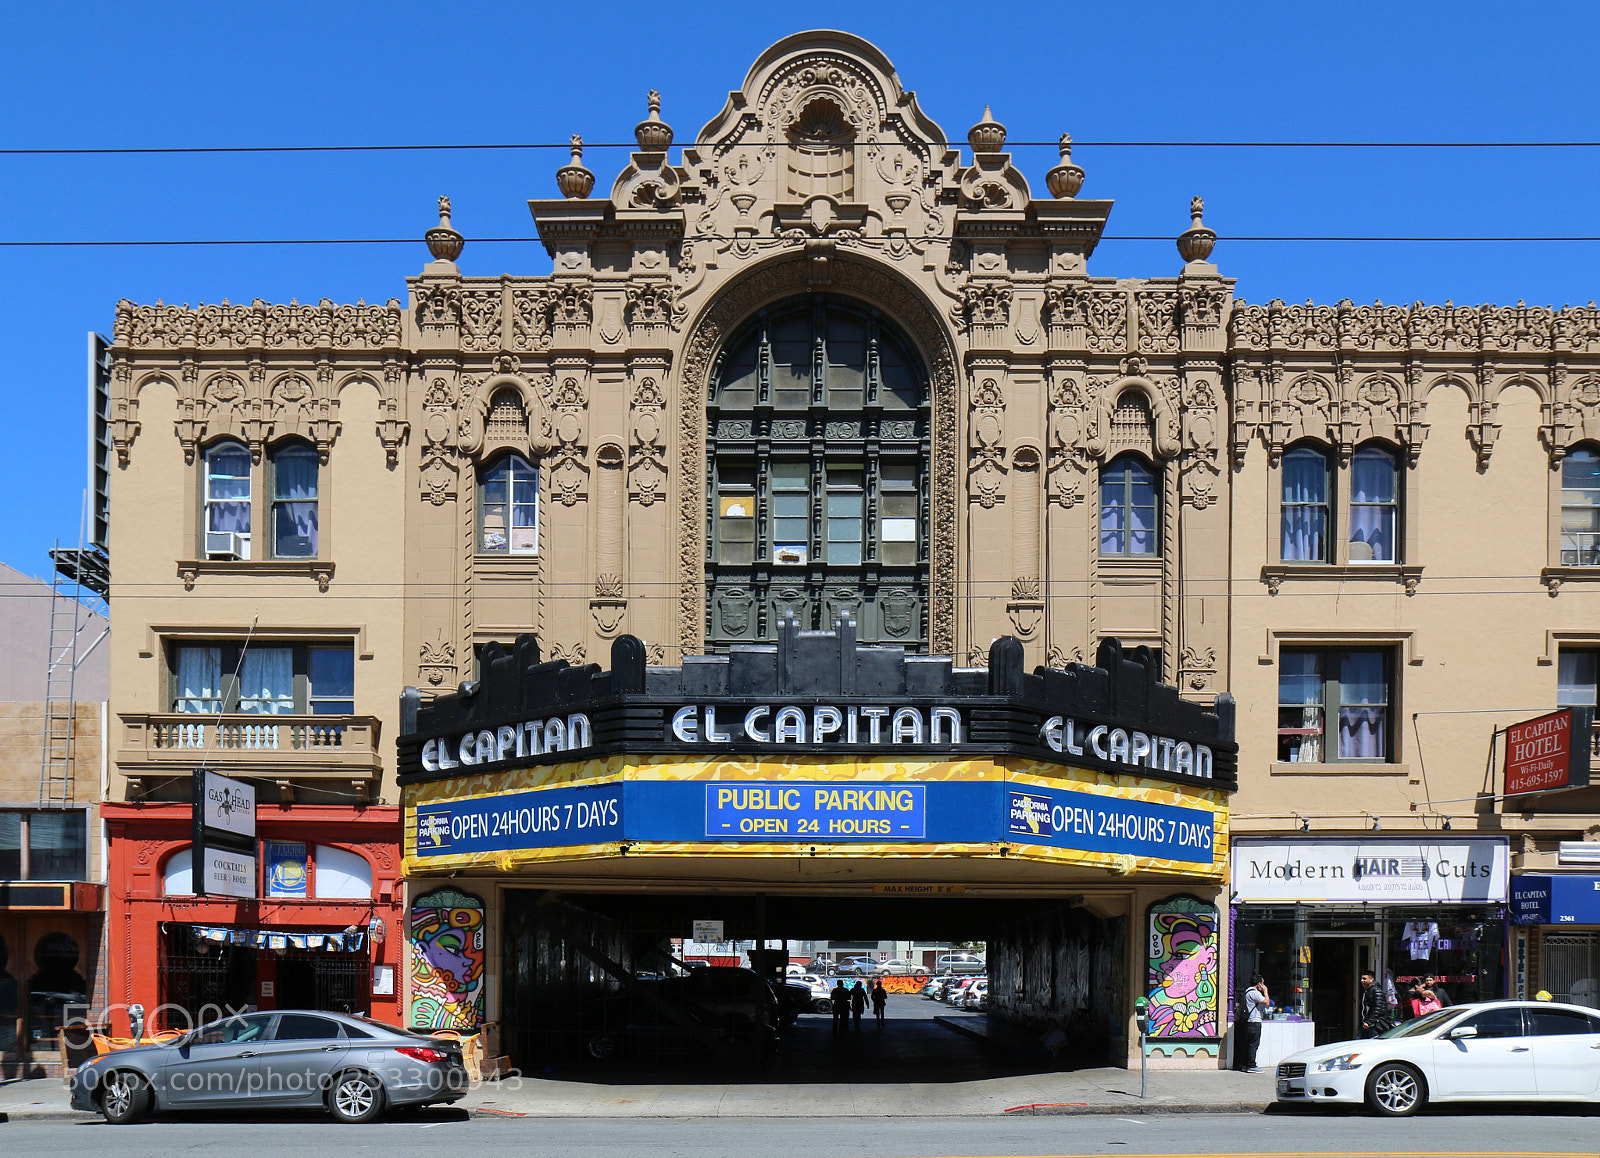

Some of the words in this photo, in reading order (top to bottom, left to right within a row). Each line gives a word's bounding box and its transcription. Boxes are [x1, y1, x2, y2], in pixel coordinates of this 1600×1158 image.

[672, 705, 731, 743] EL
[744, 705, 962, 744] CAPITAN
[1510, 730, 1523, 744] EL
[1524, 715, 1569, 739] CAPITAN
[421, 737, 459, 772] EL
[459, 713, 593, 766] CAPITAN
[1040, 715, 1083, 756] EL
[1085, 725, 1213, 779] CAPITAN
[1514, 734, 1562, 762] HOTEL
[1510, 769, 1564, 791] 415-695-1597
[208, 788, 223, 803] GAS
[231, 788, 251, 812] HEAD
[717, 789, 801, 810] PUBLIC
[814, 790, 914, 811] PARKING
[1012, 798, 1049, 811] CALIFORNIA
[420, 817, 449, 827] CALIFORNIA
[451, 812, 489, 840] OPEN
[492, 805, 560, 837] 24HOURS
[564, 804, 574, 830] 7
[577, 798, 618, 829] DAYS
[740, 818, 788, 833] OPEN
[797, 819, 820, 833] 24
[829, 819, 891, 833] HOURS
[1010, 808, 1051, 823] PARKING
[418, 825, 450, 837] PARKING
[1051, 805, 1094, 835] OPEN
[1097, 812, 1165, 844] 24HOURS
[1168, 820, 1176, 844] 7
[1178, 821, 1211, 849] DAYS
[213, 860, 247, 873] COCKTAILS
[1250, 860, 1345, 879] Modern
[1355, 858, 1401, 875] HAIR
[1435, 859, 1491, 878] Cuts
[213, 873, 228, 881] BEER
[232, 875, 247, 884] FOOD
[1515, 891, 1522, 900] EL
[1522, 890, 1547, 899] CAPITAN
[1520, 901, 1540, 910] HOTEL
